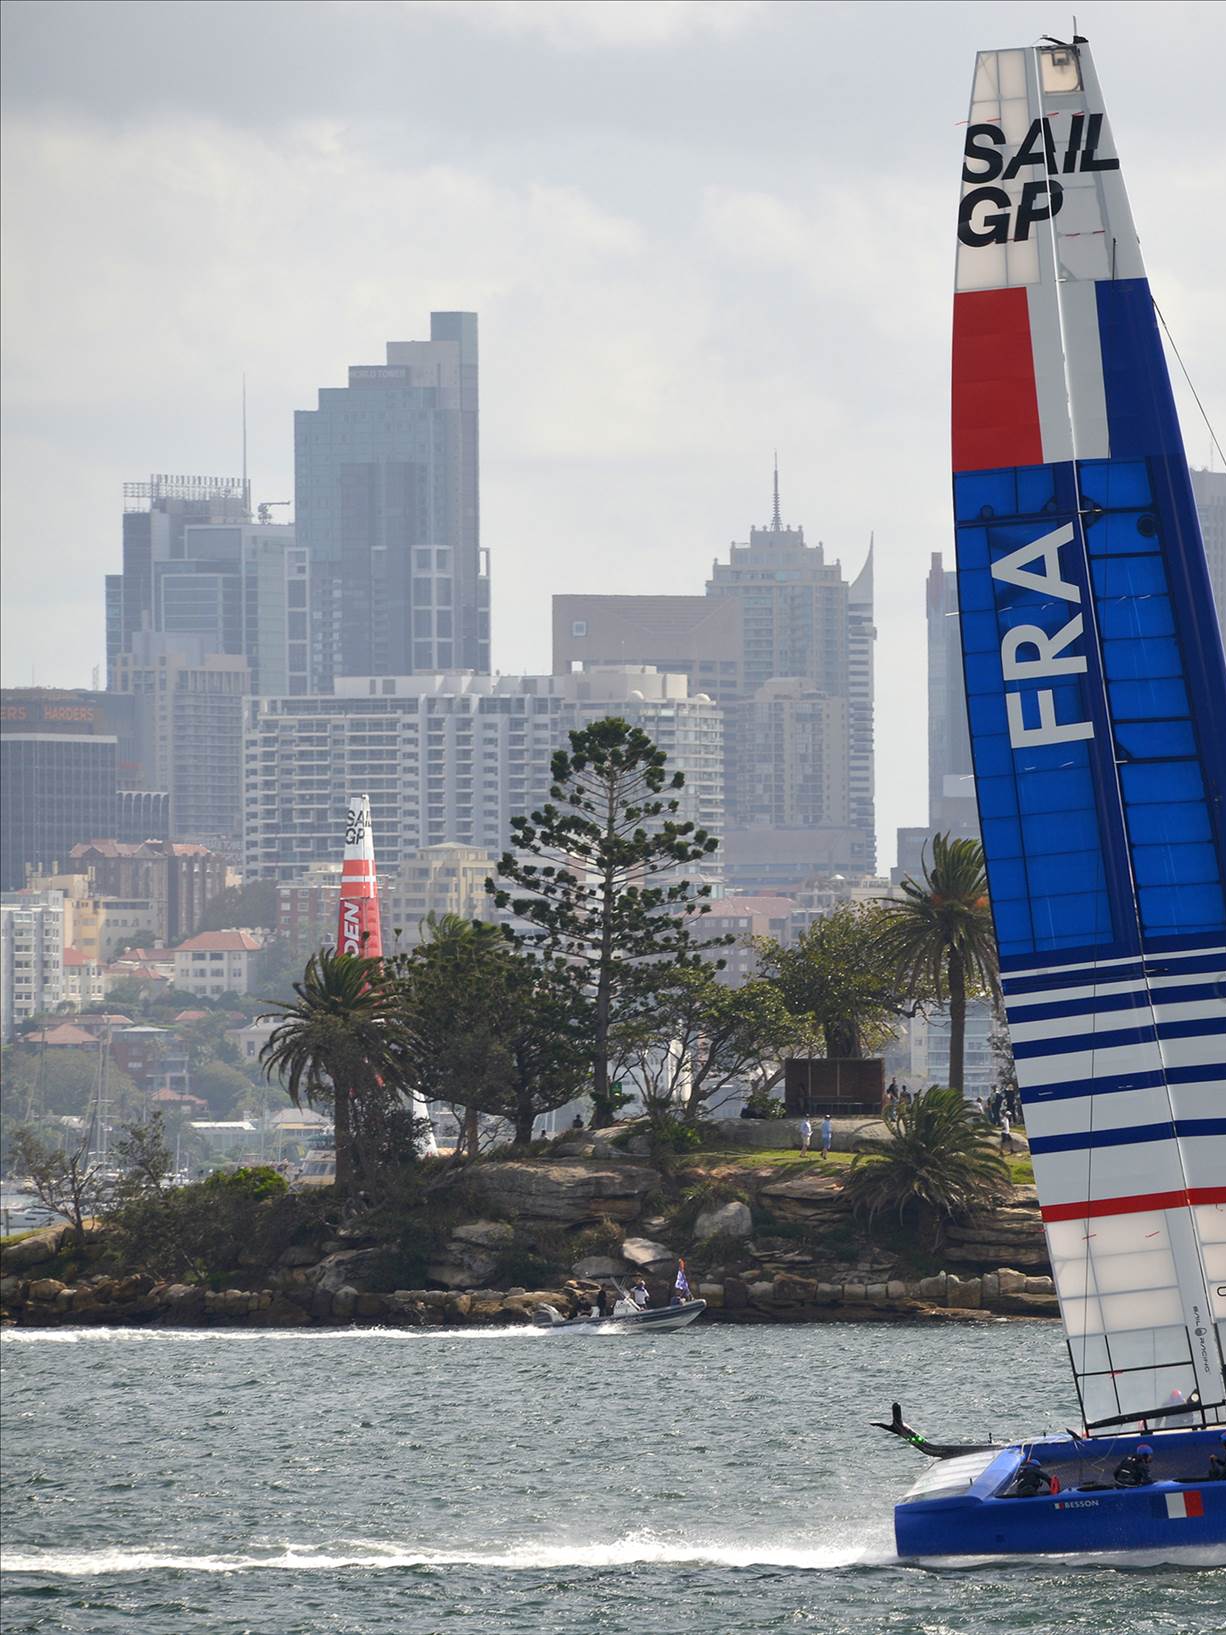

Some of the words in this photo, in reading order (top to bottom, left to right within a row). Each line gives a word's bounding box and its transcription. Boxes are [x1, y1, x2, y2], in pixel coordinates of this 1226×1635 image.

[961, 113, 1120, 184] SAIL
[957, 179, 1065, 248] GP
[990, 521, 1095, 749] FRA
[345, 809, 372, 828] SAIL
[345, 827, 366, 845] GP
[1064, 1499, 1100, 1509] BESSON
